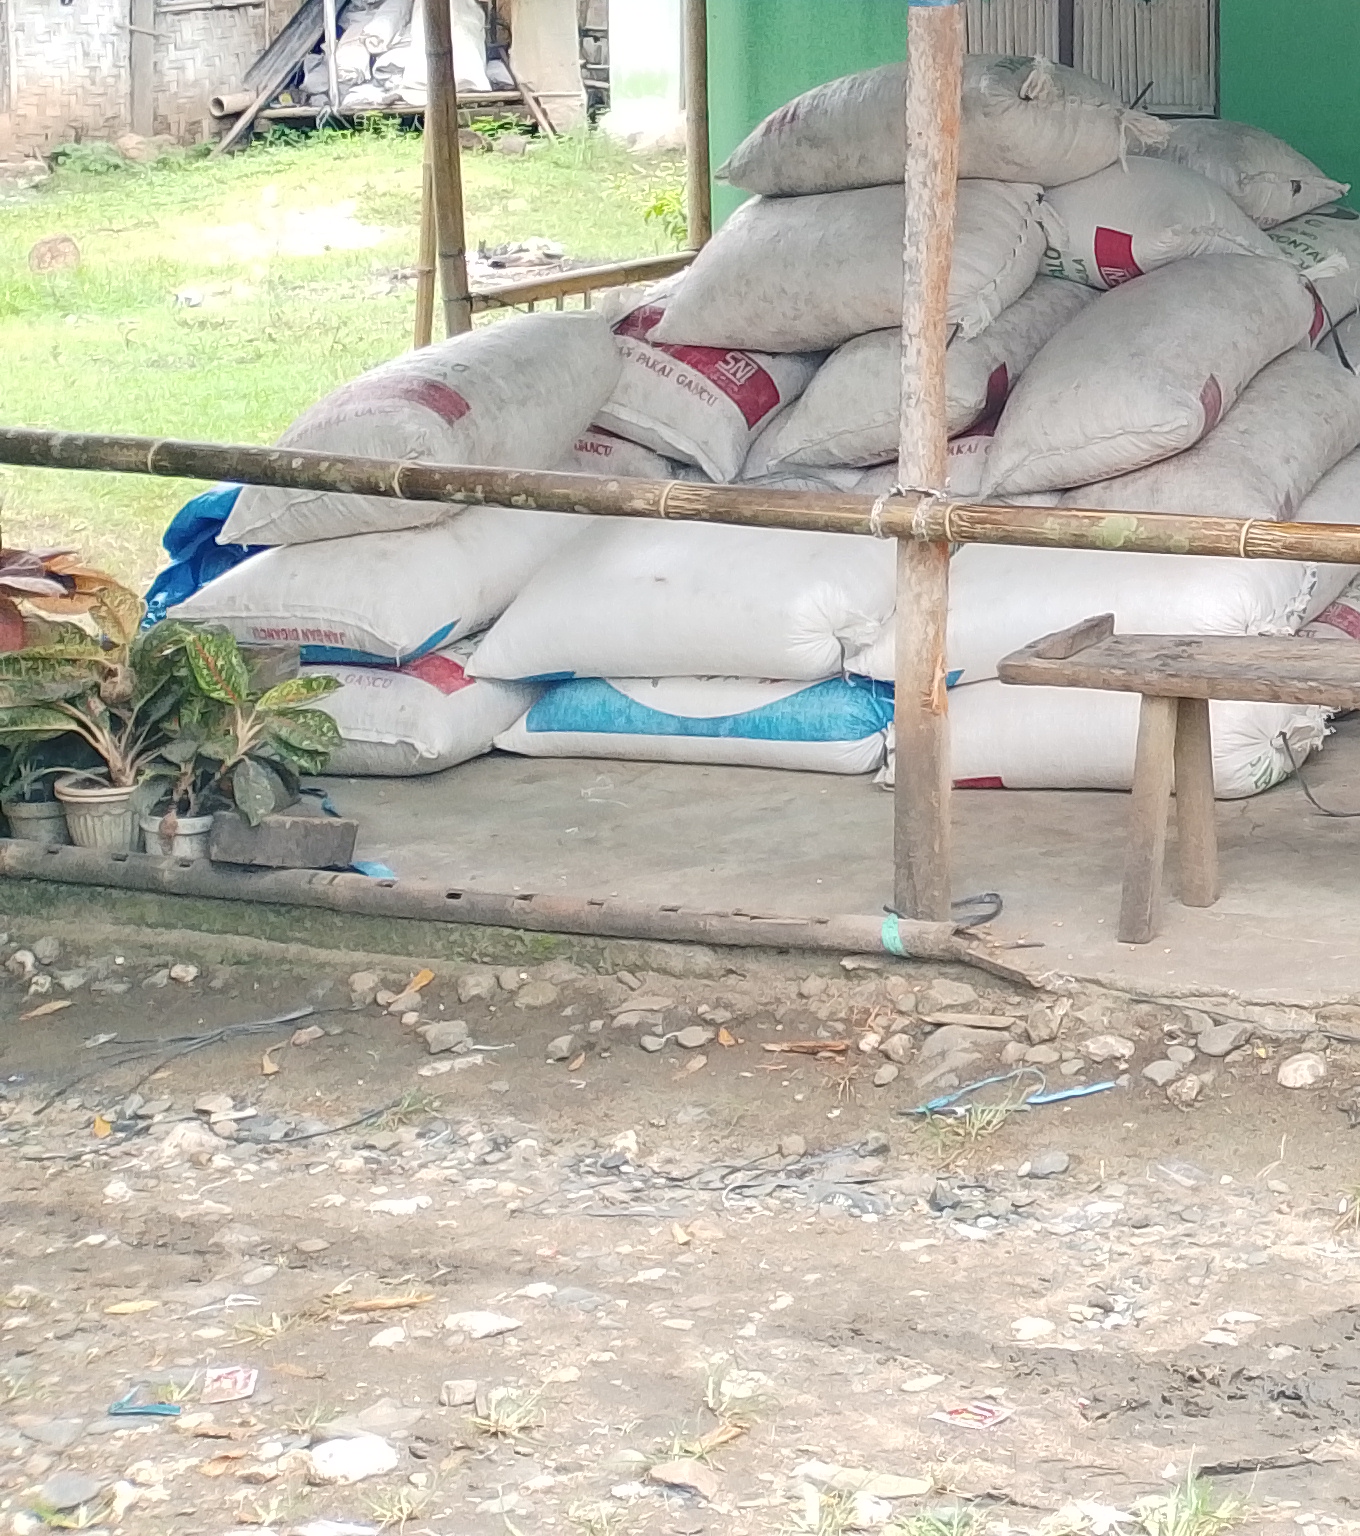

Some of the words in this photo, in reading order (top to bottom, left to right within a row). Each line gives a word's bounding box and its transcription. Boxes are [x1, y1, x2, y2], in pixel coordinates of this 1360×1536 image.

[636, 351, 673, 379] PAKAI
[675, 373, 719, 407] GANCU
[716, 350, 757, 384] SNI
